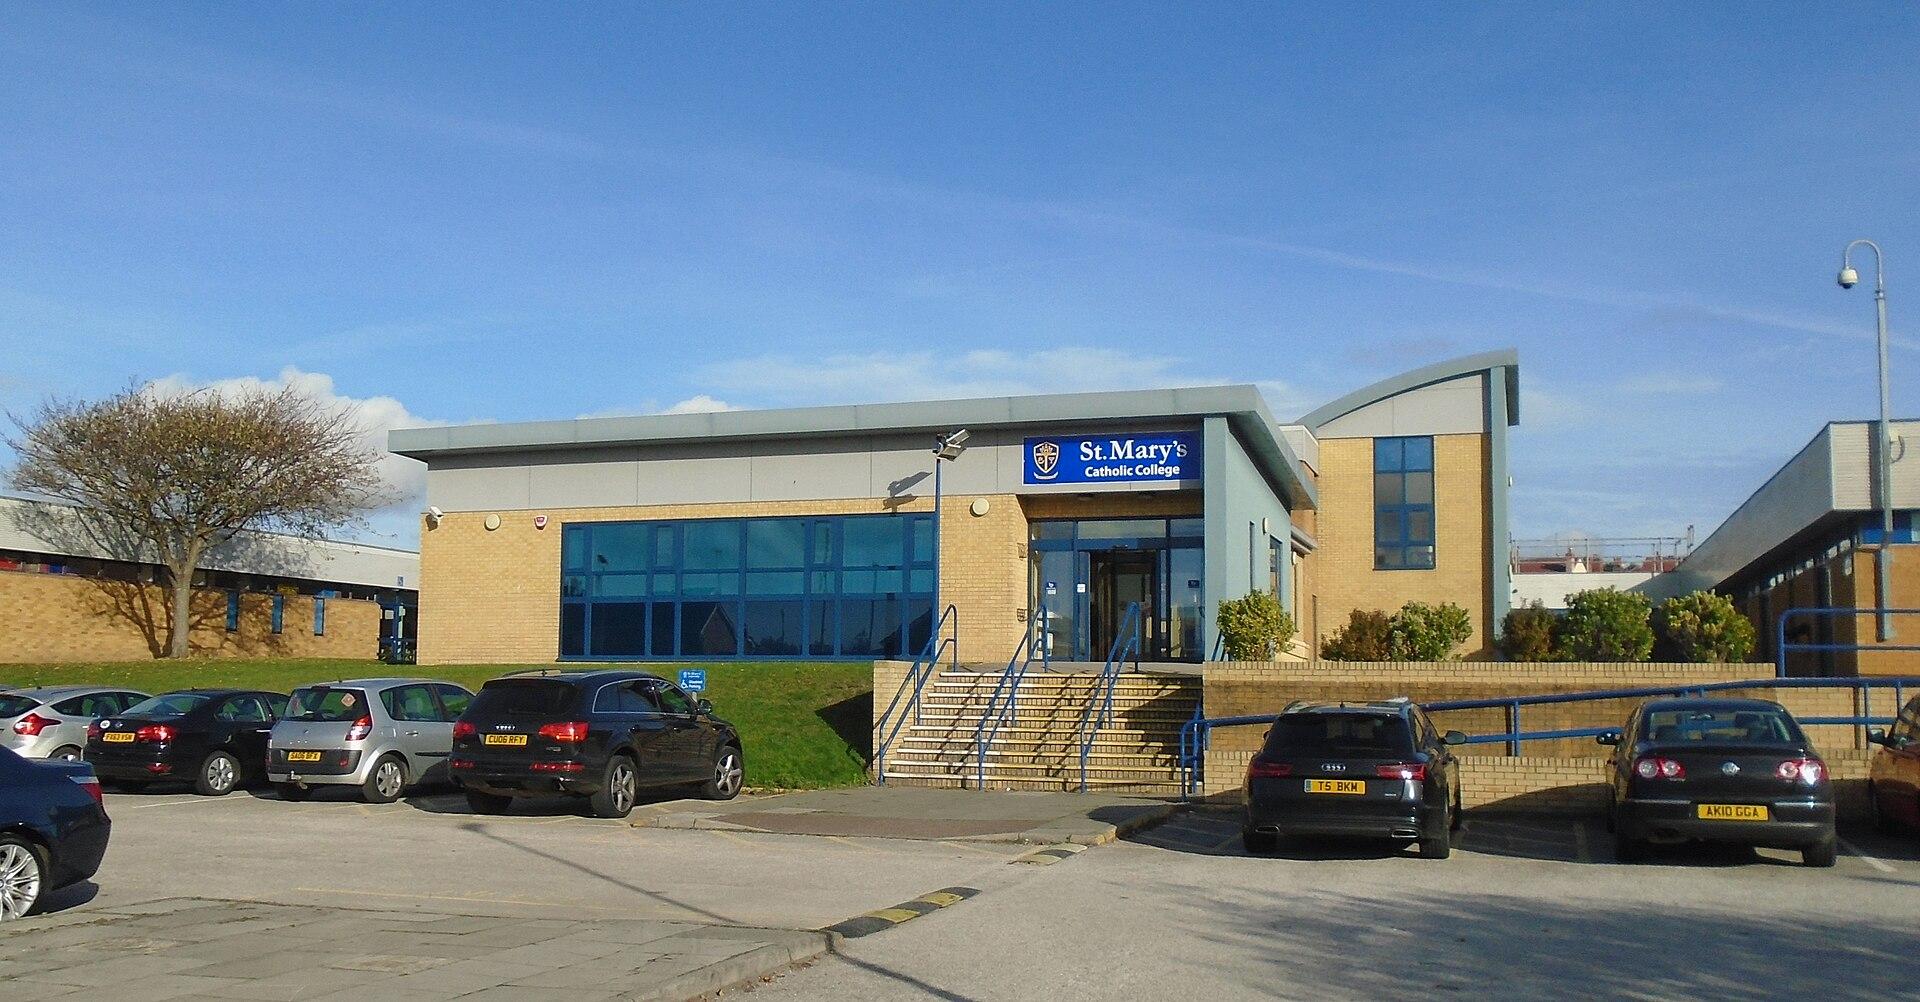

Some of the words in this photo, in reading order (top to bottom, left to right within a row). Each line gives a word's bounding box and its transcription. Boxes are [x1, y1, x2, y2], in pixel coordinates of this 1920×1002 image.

[1085, 465, 1133, 477] Catholic
[1135, 464, 1180, 477] College
[488, 735, 508, 744] CU06
[508, 735, 524, 744] RFY
[1317, 781, 1331, 791] T5
[1706, 805, 1732, 816] AK10
[1736, 806, 1759, 817] GGA
